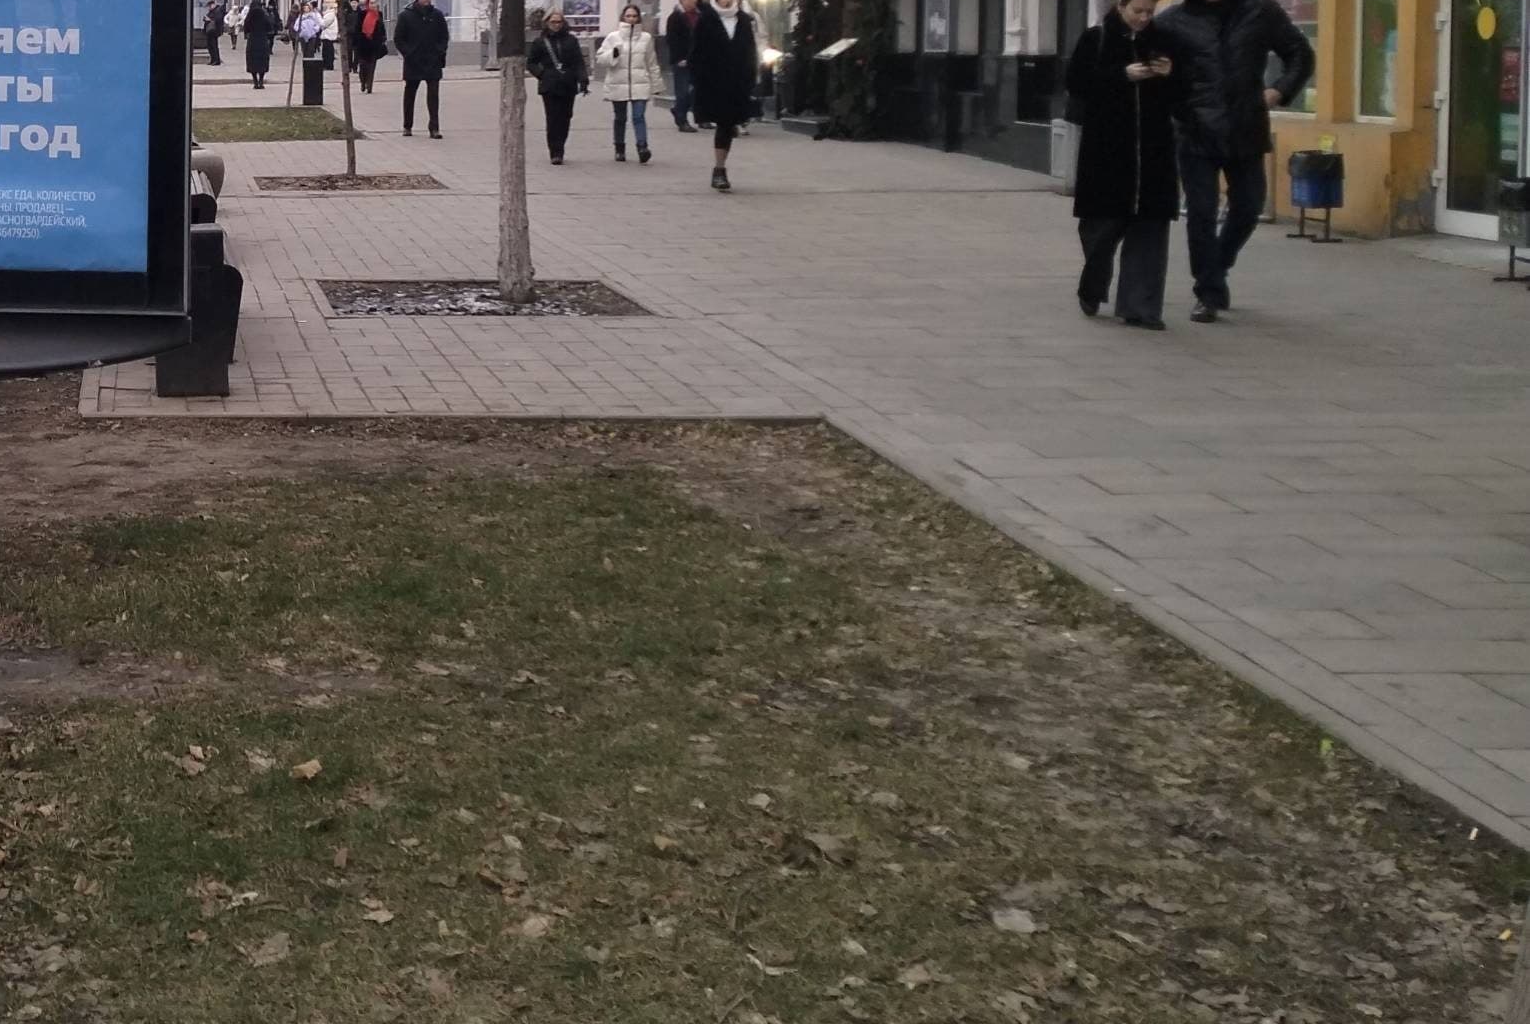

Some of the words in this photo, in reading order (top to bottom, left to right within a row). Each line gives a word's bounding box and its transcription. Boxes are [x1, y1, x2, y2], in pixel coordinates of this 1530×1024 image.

[0, 123, 81, 159] год
[37, 190, 96, 202] КОЛИЧЕСТВО
[15, 202, 64, 214] ПРОДАВЕЦ
